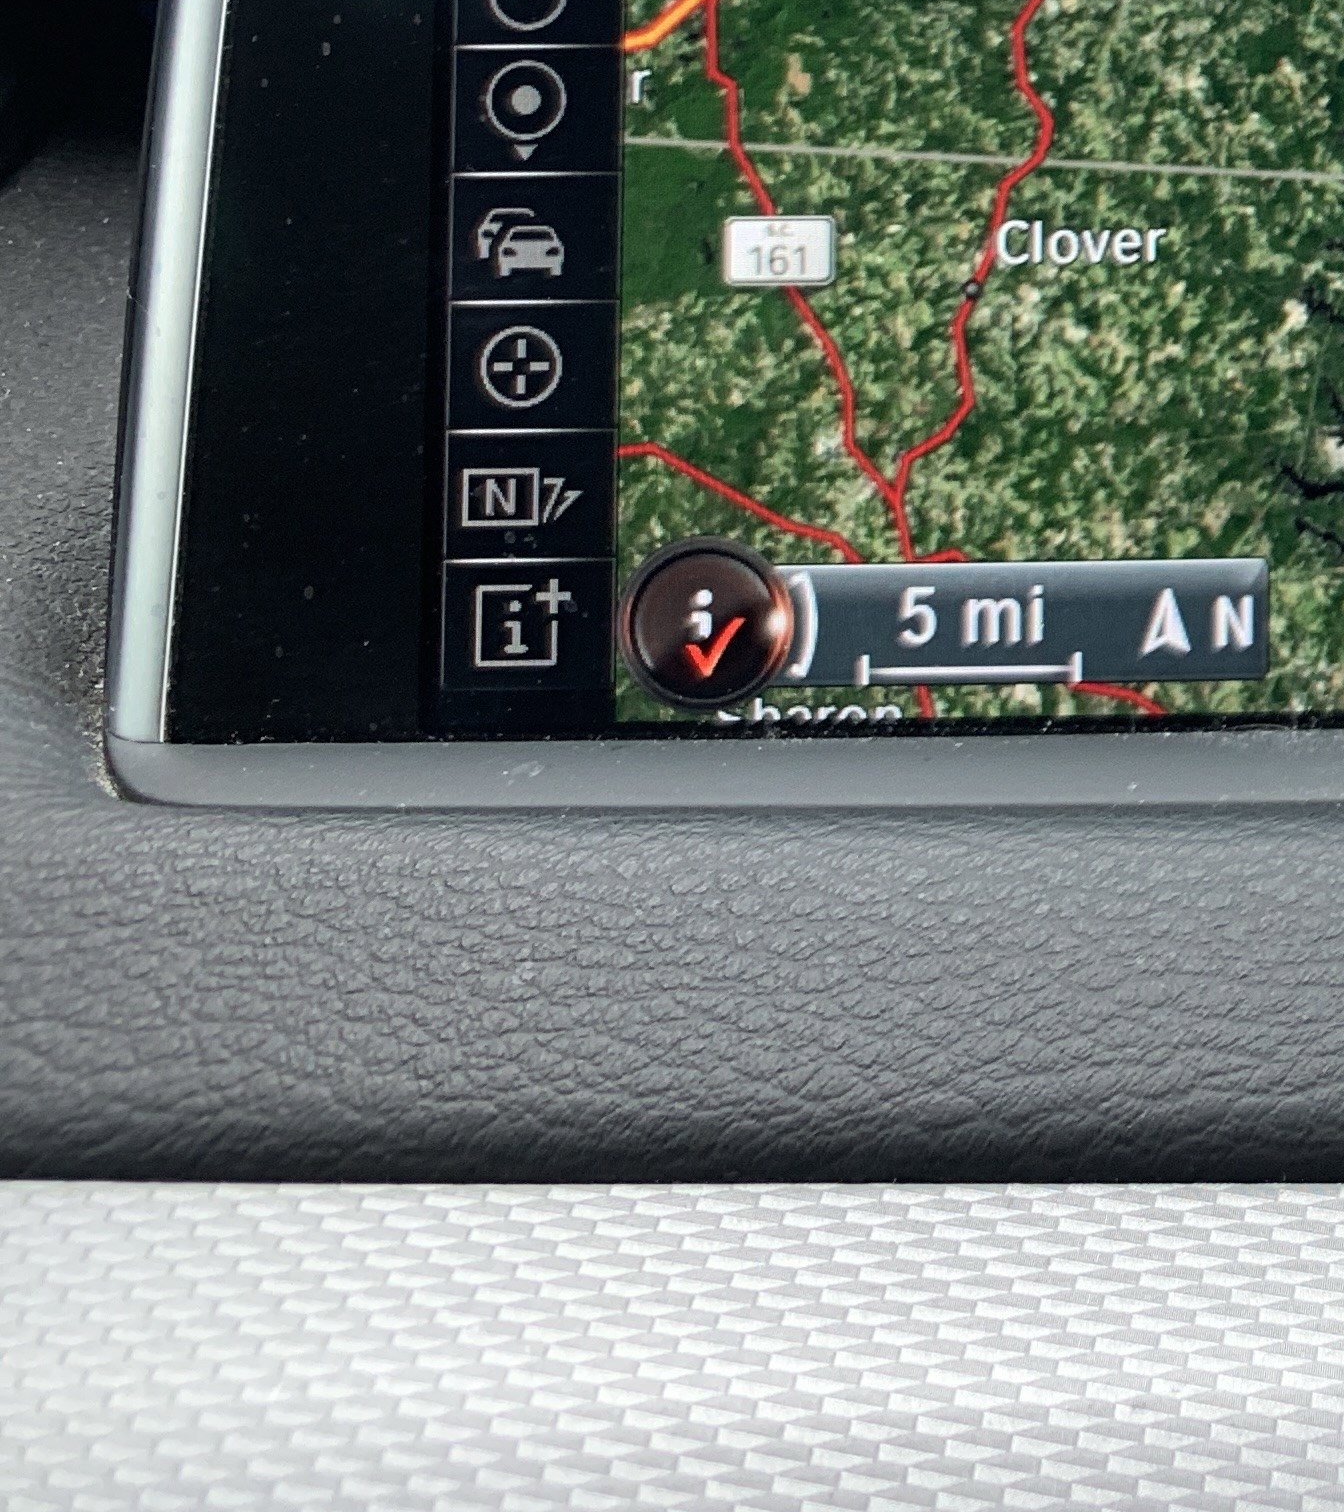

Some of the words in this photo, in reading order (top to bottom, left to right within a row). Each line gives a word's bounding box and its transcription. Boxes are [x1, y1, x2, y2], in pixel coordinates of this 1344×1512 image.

[747, 245, 806, 275] 161
[998, 221, 1168, 265] Clover
[899, 586, 938, 644] 5
[962, 585, 1045, 646] mi
[1212, 595, 1254, 648] N
